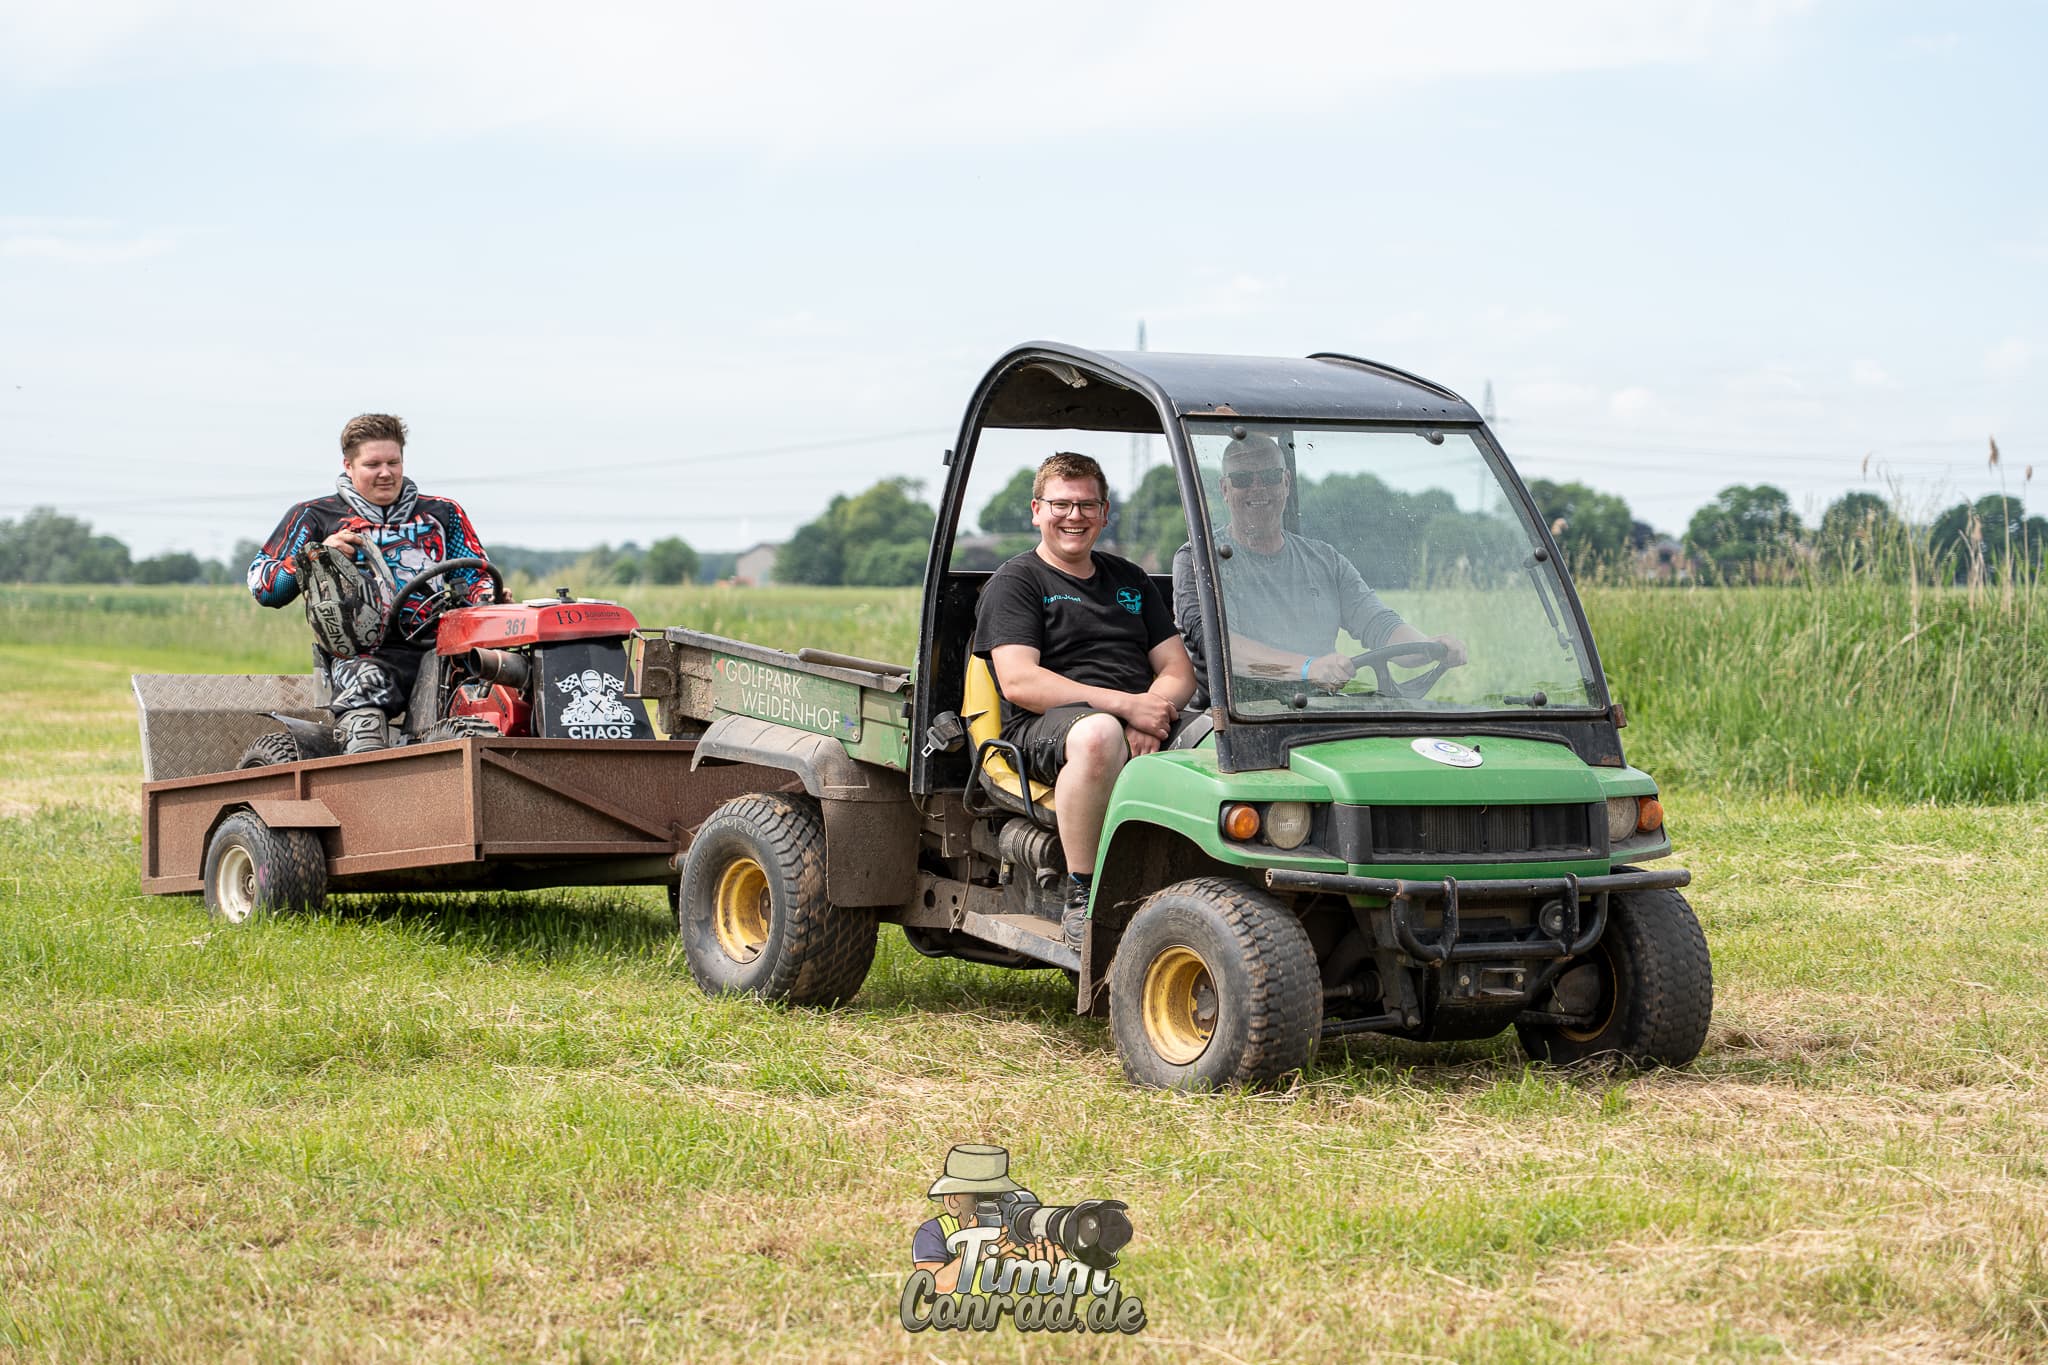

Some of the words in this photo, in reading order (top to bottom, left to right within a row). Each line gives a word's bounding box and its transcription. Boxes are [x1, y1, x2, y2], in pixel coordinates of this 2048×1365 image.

[505, 617, 526, 636] 361
[725, 659, 802, 699] GOLFPARK
[741, 687, 840, 732] WEIDENHOF
[568, 725, 633, 740] CHAOS
